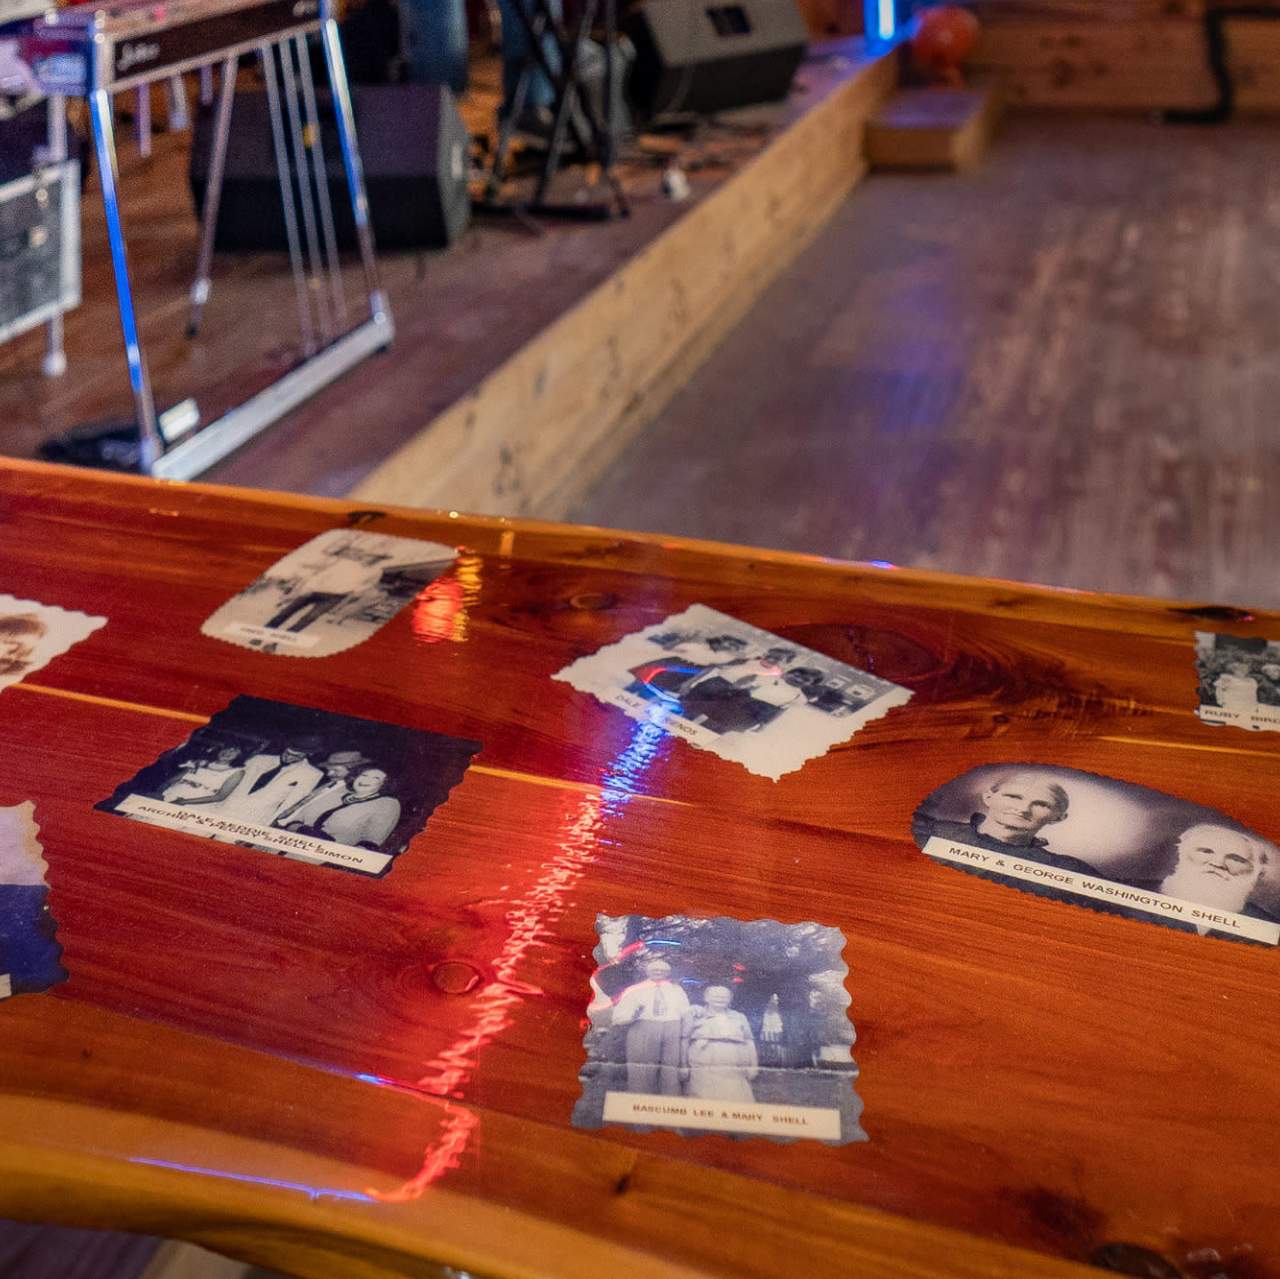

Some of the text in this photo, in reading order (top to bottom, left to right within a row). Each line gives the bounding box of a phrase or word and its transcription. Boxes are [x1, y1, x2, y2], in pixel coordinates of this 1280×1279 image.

[1204, 710, 1240, 719] RUBY
[137, 805, 188, 821] ARCHIE
[314, 847, 364, 863] SIMON
[948, 846, 1241, 928] MARY & GEORGE WASHINGTON SHELL
[633, 1104, 688, 1116] BASCUMB
[693, 1110, 714, 1118] LEE
[732, 1113, 763, 1122] MARY
[772, 1117, 809, 1126] SHELL
